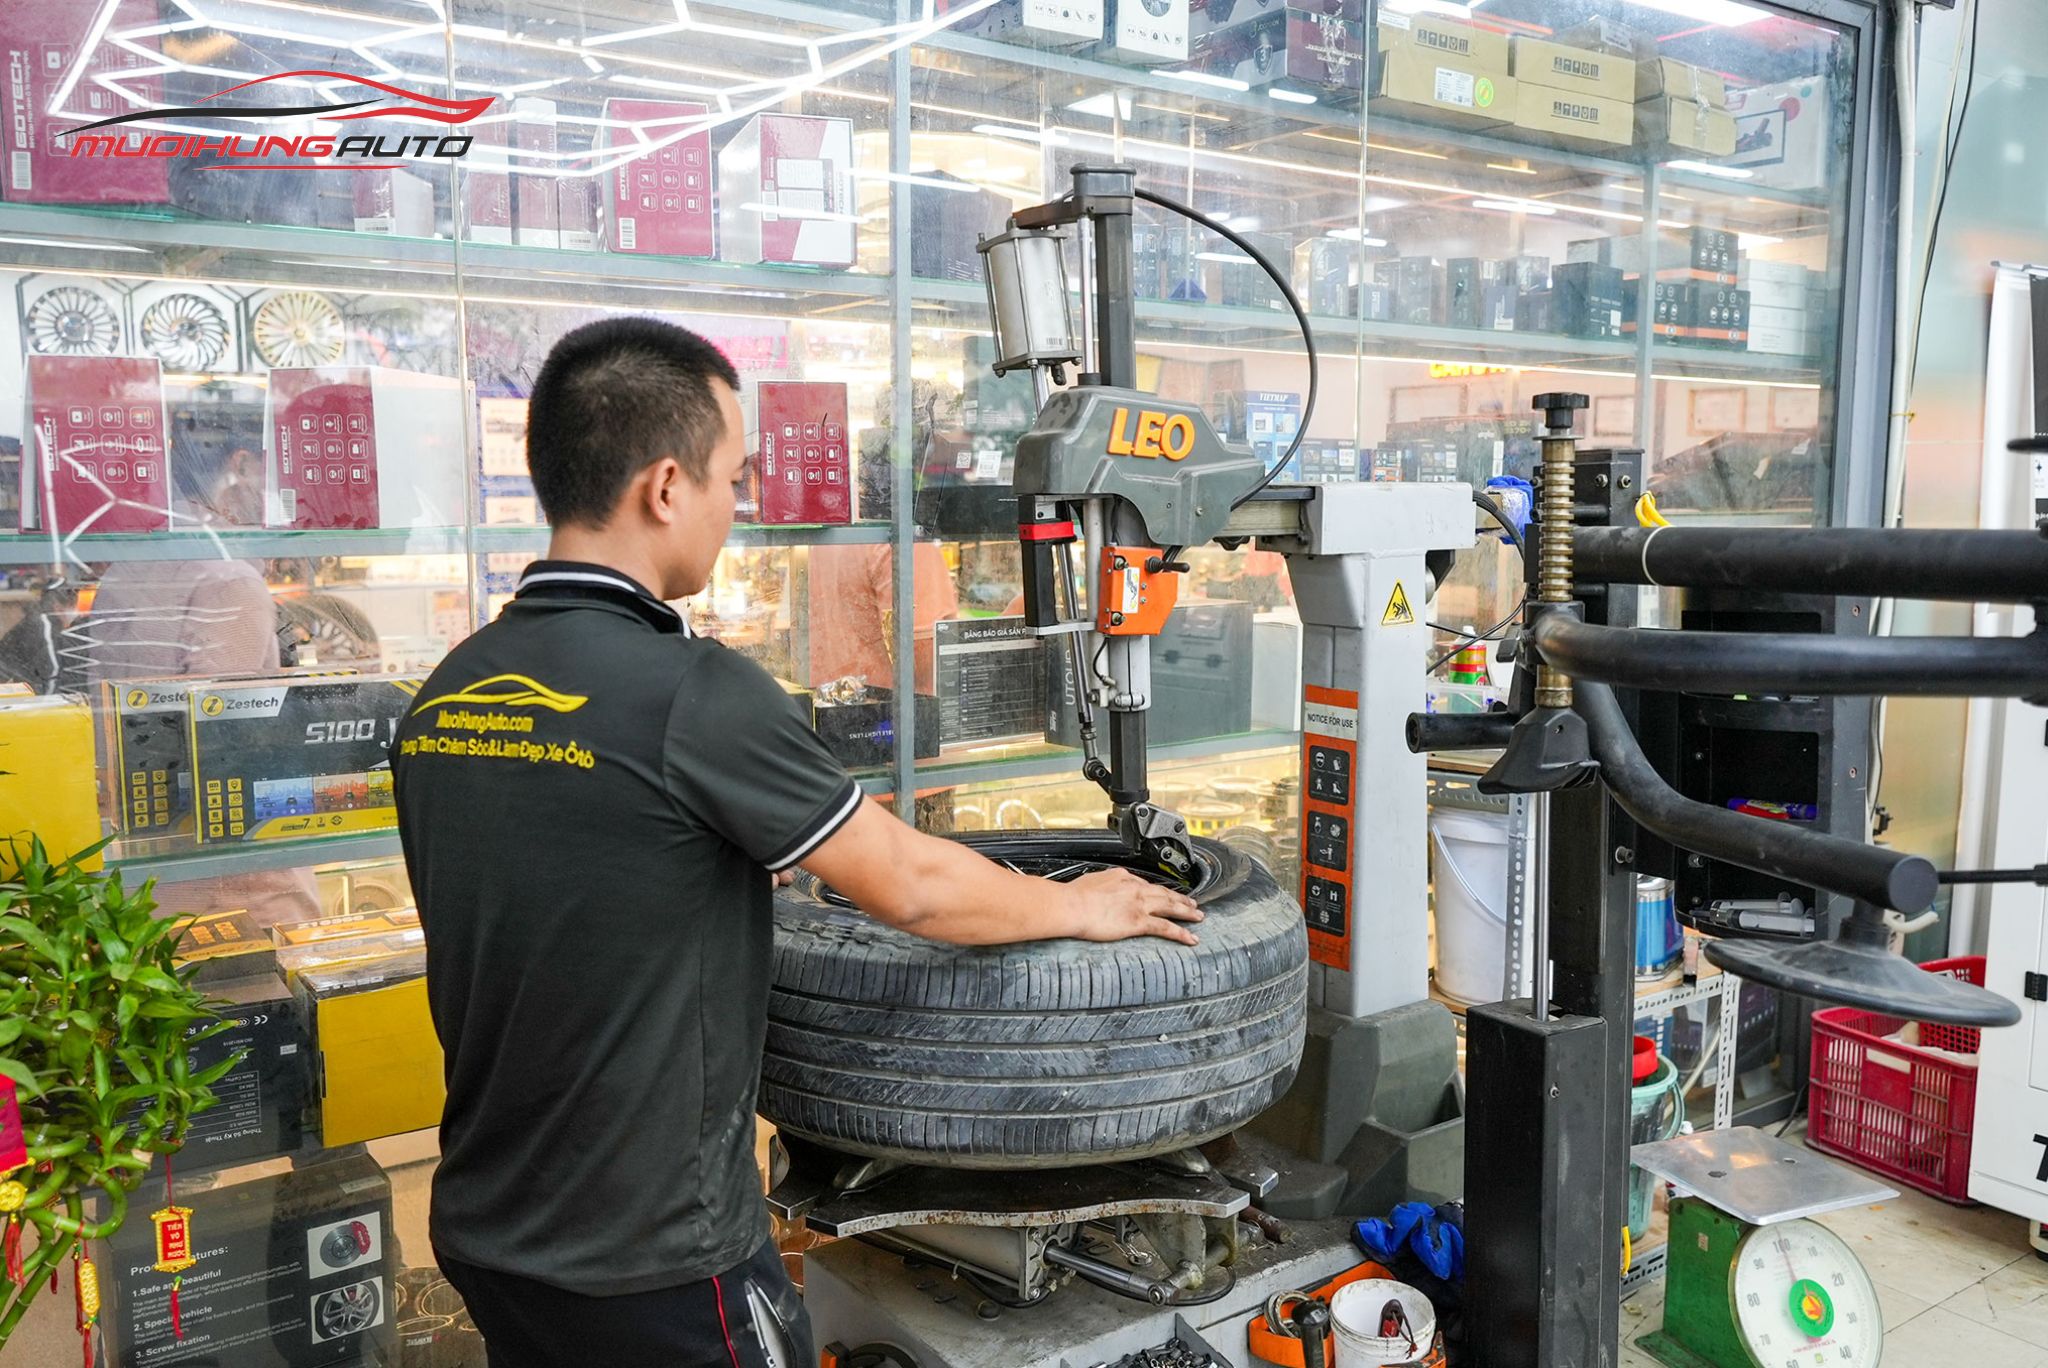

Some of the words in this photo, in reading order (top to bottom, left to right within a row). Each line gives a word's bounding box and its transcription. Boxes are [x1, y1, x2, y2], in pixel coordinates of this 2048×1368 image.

[1106, 407, 1196, 462] LEO
[983, 628, 996, 638] BÁO
[226, 697, 279, 711] Zestech
[1307, 713, 1328, 724] NOTICE
[1329, 717, 1340, 726] FOR
[1342, 719, 1353, 728] USE
[304, 718, 376, 745] S100
[849, 732, 864, 740] LENS
[545, 743, 564, 763] Xe
[192, 1245, 229, 1261] tures:
[1772, 1238, 1791, 1254] 100
[182, 1269, 222, 1286] beautiful
[1832, 1272, 1845, 1287] 20
[1747, 1292, 1760, 1308] 80
[180, 1305, 213, 1320] vehicle
[1846, 1312, 1857, 1324] 30
[145, 1342, 176, 1357] Screw
[176, 1332, 210, 1348] fixation
[1839, 1345, 1852, 1360] 40
